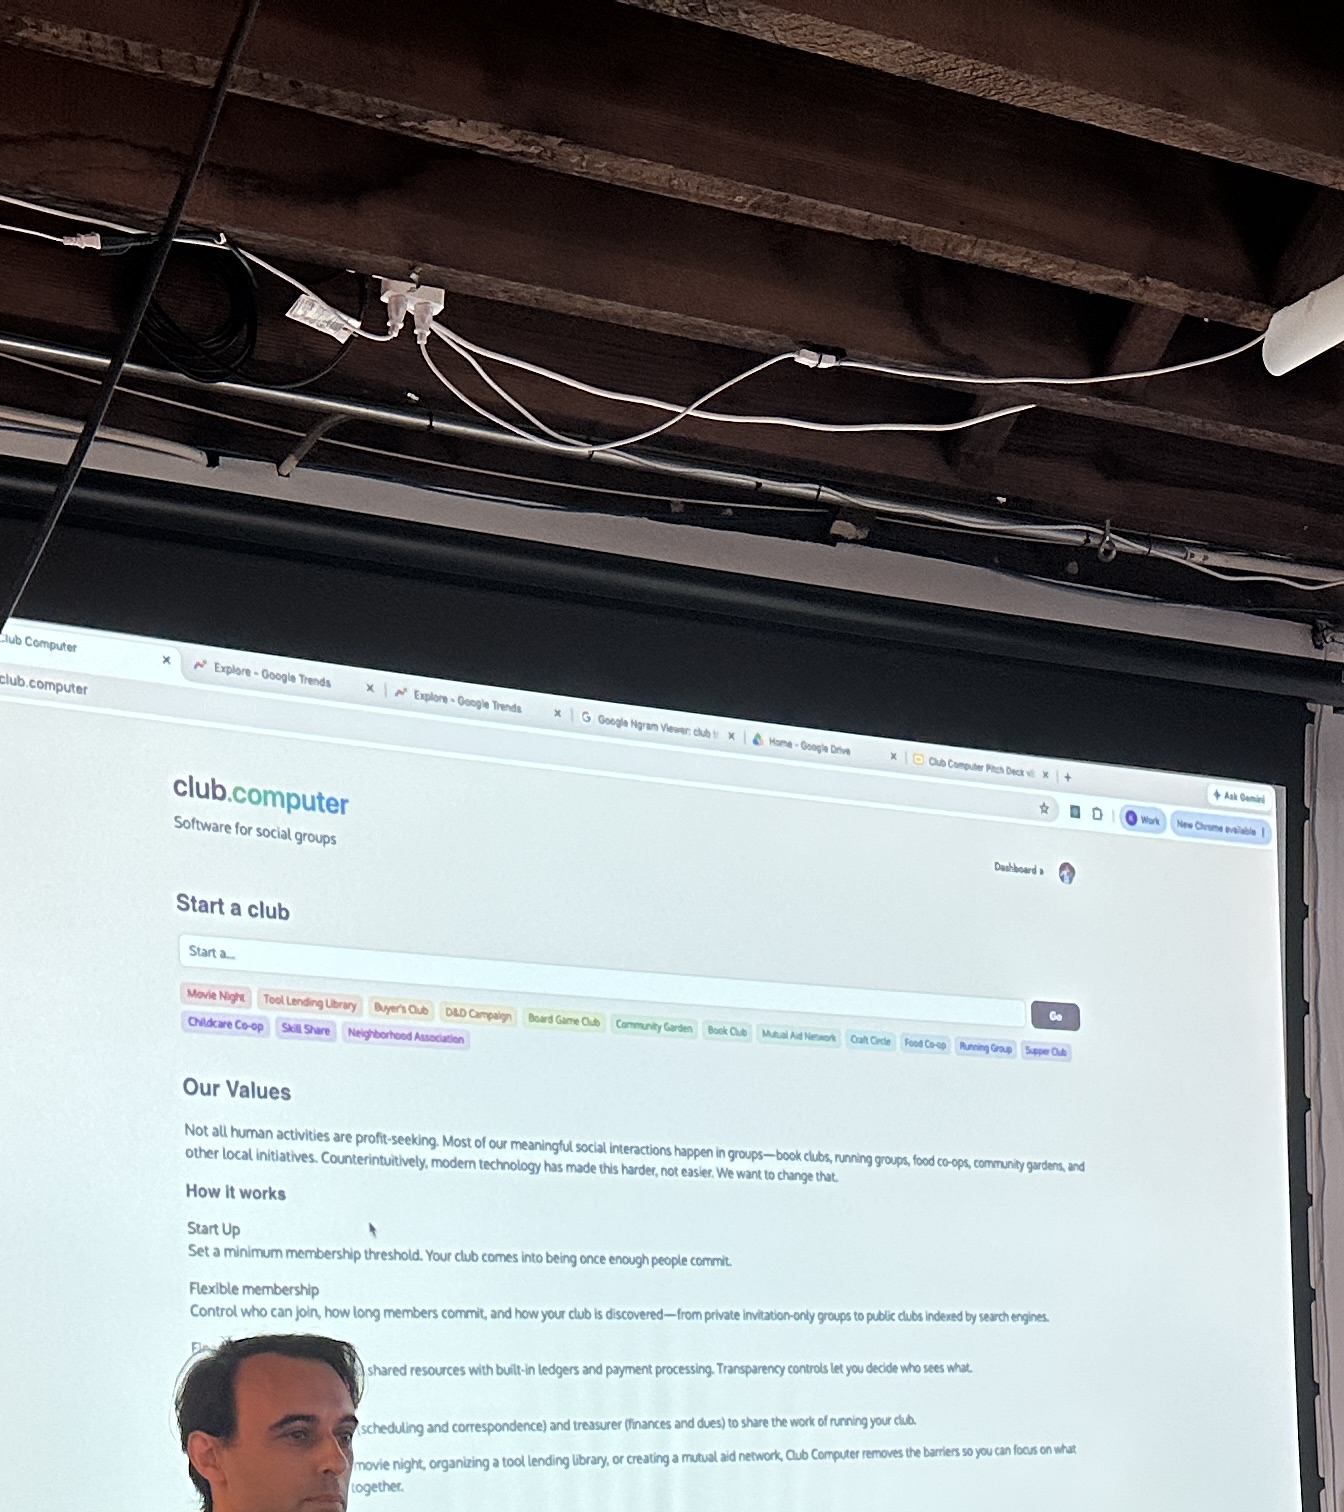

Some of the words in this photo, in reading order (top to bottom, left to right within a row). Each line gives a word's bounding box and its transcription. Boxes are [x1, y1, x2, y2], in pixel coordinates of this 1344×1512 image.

[24, 635, 77, 653] Computer
[214, 662, 252, 677] Explore
[261, 668, 296, 684] Google
[299, 673, 331, 688] Trends
[769, 737, 794, 749] Home
[800, 740, 829, 754] Google
[830, 744, 852, 757] Drive
[173, 775, 349, 815] club.computer
[174, 815, 232, 834] Software
[235, 821, 253, 836] for
[256, 827, 292, 841] social
[294, 831, 337, 847] groups
[994, 861, 1037, 876] Dashboard
[176, 893, 225, 915] Start
[230, 902, 242, 917] a
[248, 900, 290, 921] club
[189, 944, 217, 959] Start
[187, 988, 217, 1001] Movie
[219, 990, 245, 1005] Night
[264, 993, 285, 1005] Tool
[286, 996, 324, 1011] Lending
[325, 998, 357, 1013] Library
[374, 1001, 407, 1015] Buyer's
[408, 1004, 429, 1016] Club
[445, 1007, 467, 1018] D&D
[469, 1008, 512, 1024] Campaign
[1048, 1011, 1063, 1022] Go
[187, 1016, 233, 1030] Childcare
[234, 1019, 264, 1034] Co-op
[528, 1012, 554, 1024] Board
[555, 1015, 580, 1026] Game
[581, 1016, 600, 1027] Club
[616, 1019, 662, 1034] Community
[663, 1022, 693, 1033] Garden
[281, 1022, 302, 1034] Skill
[304, 1024, 331, 1036] Share
[347, 1027, 413, 1041] Neighborhood
[414, 1031, 465, 1044] Association
[707, 1025, 728, 1036] Book
[729, 1026, 748, 1037] Club
[762, 1029, 789, 1040] Mutual
[790, 1031, 804, 1041] Aid
[803, 1031, 837, 1042] Network
[850, 1034, 869, 1045] Craft
[870, 1035, 892, 1046] Circle
[904, 1037, 925, 1048] Food
[924, 1039, 948, 1051] Co-op
[959, 1041, 991, 1054] Running
[990, 1044, 1013, 1055] Group
[1025, 1045, 1051, 1058] Supper
[1050, 1046, 1068, 1057] Club
[183, 1077, 220, 1097] Our
[226, 1079, 291, 1101] Values
[184, 1122, 209, 1137] Not
[212, 1124, 228, 1138] all
[230, 1125, 273, 1140] human
[276, 1128, 330, 1142] activities
[333, 1132, 352, 1143] are
[355, 1131, 439, 1149] profit-seeking.
[442, 1134, 472, 1149] Most
[474, 1135, 486, 1149] of
[488, 1139, 507, 1150] our
[510, 1139, 573, 1156] meaningful
[576, 1142, 607, 1154] social
[609, 1142, 672, 1157] interactions
[674, 1145, 714, 1161] happen
[715, 1147, 726, 1159] in
[804, 1150, 832, 1164] clubs,
[834, 1153, 873, 1168] running
[874, 1155, 910, 1168] groups,
[913, 1154, 935, 1167] food
[937, 1158, 971, 1171] co-ops,
[973, 1159, 1025, 1173] community
[1026, 1160, 1065, 1173] gardens,
[1068, 1161, 1085, 1172] and
[185, 1146, 219, 1160] other
[222, 1146, 253, 1161] local
[256, 1148, 318, 1164] initiatives.
[321, 1151, 428, 1171] Counterintuitively,
[431, 1157, 476, 1170] modern
[479, 1158, 541, 1176] technology
[543, 1160, 563, 1173] has
[565, 1162, 597, 1175] made
[599, 1162, 619, 1175] this
[621, 1163, 658, 1178] harder,
[660, 1166, 679, 1177] not
[681, 1167, 714, 1178] easier.
[716, 1167, 734, 1179] We
[736, 1169, 762, 1180] want
[764, 1170, 775, 1181] to
[777, 1169, 813, 1185] change
[816, 1170, 838, 1183] that.
[186, 1183, 221, 1199] How
[225, 1184, 235, 1199] it
[239, 1186, 286, 1201] works
[187, 1221, 219, 1236] Start
[222, 1222, 241, 1240] Up
[188, 1243, 210, 1258] Set
[213, 1247, 221, 1258] a
[223, 1246, 283, 1259] minimum
[285, 1247, 361, 1264] membership
[364, 1247, 423, 1262] threshold.
[425, 1248, 452, 1263] Your
[454, 1249, 479, 1263] club
[481, 1253, 518, 1263] comes
[521, 1251, 543, 1264] into
[545, 1251, 577, 1268] being
[579, 1255, 606, 1265] once
[608, 1253, 649, 1268] enough
[651, 1254, 688, 1269] people
[690, 1255, 732, 1267] commit.
[189, 1281, 239, 1295] Flexible
[242, 1283, 319, 1300] membership
[367, 1363, 407, 1377] shared
[410, 1366, 466, 1377] resources
[468, 1364, 494, 1376] with
[495, 1363, 535, 1376] built-in
[538, 1363, 579, 1379] ledgers
[582, 1363, 603, 1375] and
[605, 1364, 653, 1378] payment
[655, 1363, 714, 1379] processing.
[717, 1363, 785, 1378] Transparency
[787, 1362, 828, 1374] controls
[830, 1362, 844, 1374] let
[846, 1364, 864, 1377] you
[866, 1362, 898, 1374] decide
[900, 1361, 921, 1373] who
[923, 1364, 944, 1373] sees
[947, 1362, 972, 1373] what.
[351, 1481, 404, 1496] together.
